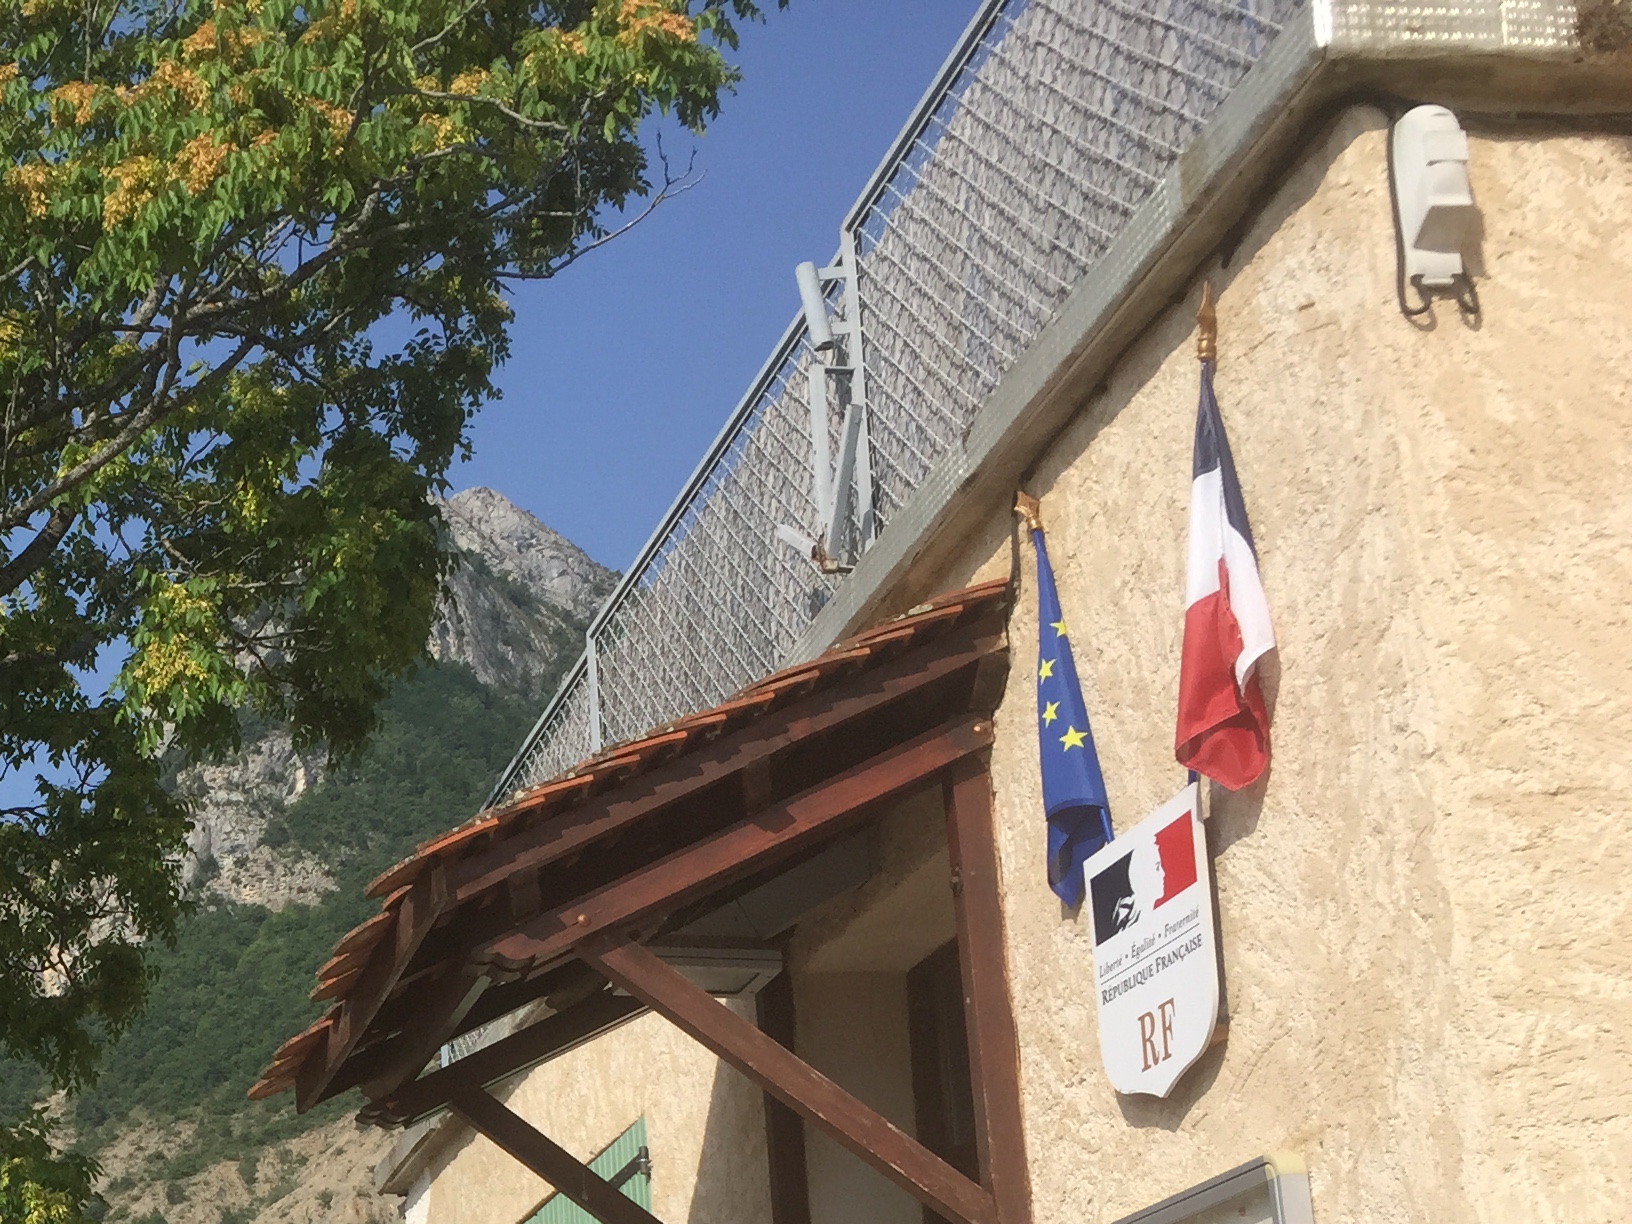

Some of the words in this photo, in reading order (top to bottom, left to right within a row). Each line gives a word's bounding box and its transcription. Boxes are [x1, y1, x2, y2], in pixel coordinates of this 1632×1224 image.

[1099, 953, 1123, 978] Liberté
[1130, 934, 1155, 960] Égalité
[1163, 905, 1200, 939] Fraternité
[1101, 963, 1155, 1005] RÉPUBLIQUE
[1154, 933, 1203, 975] FRANÇAISE
[1137, 998, 1176, 1073] RF
